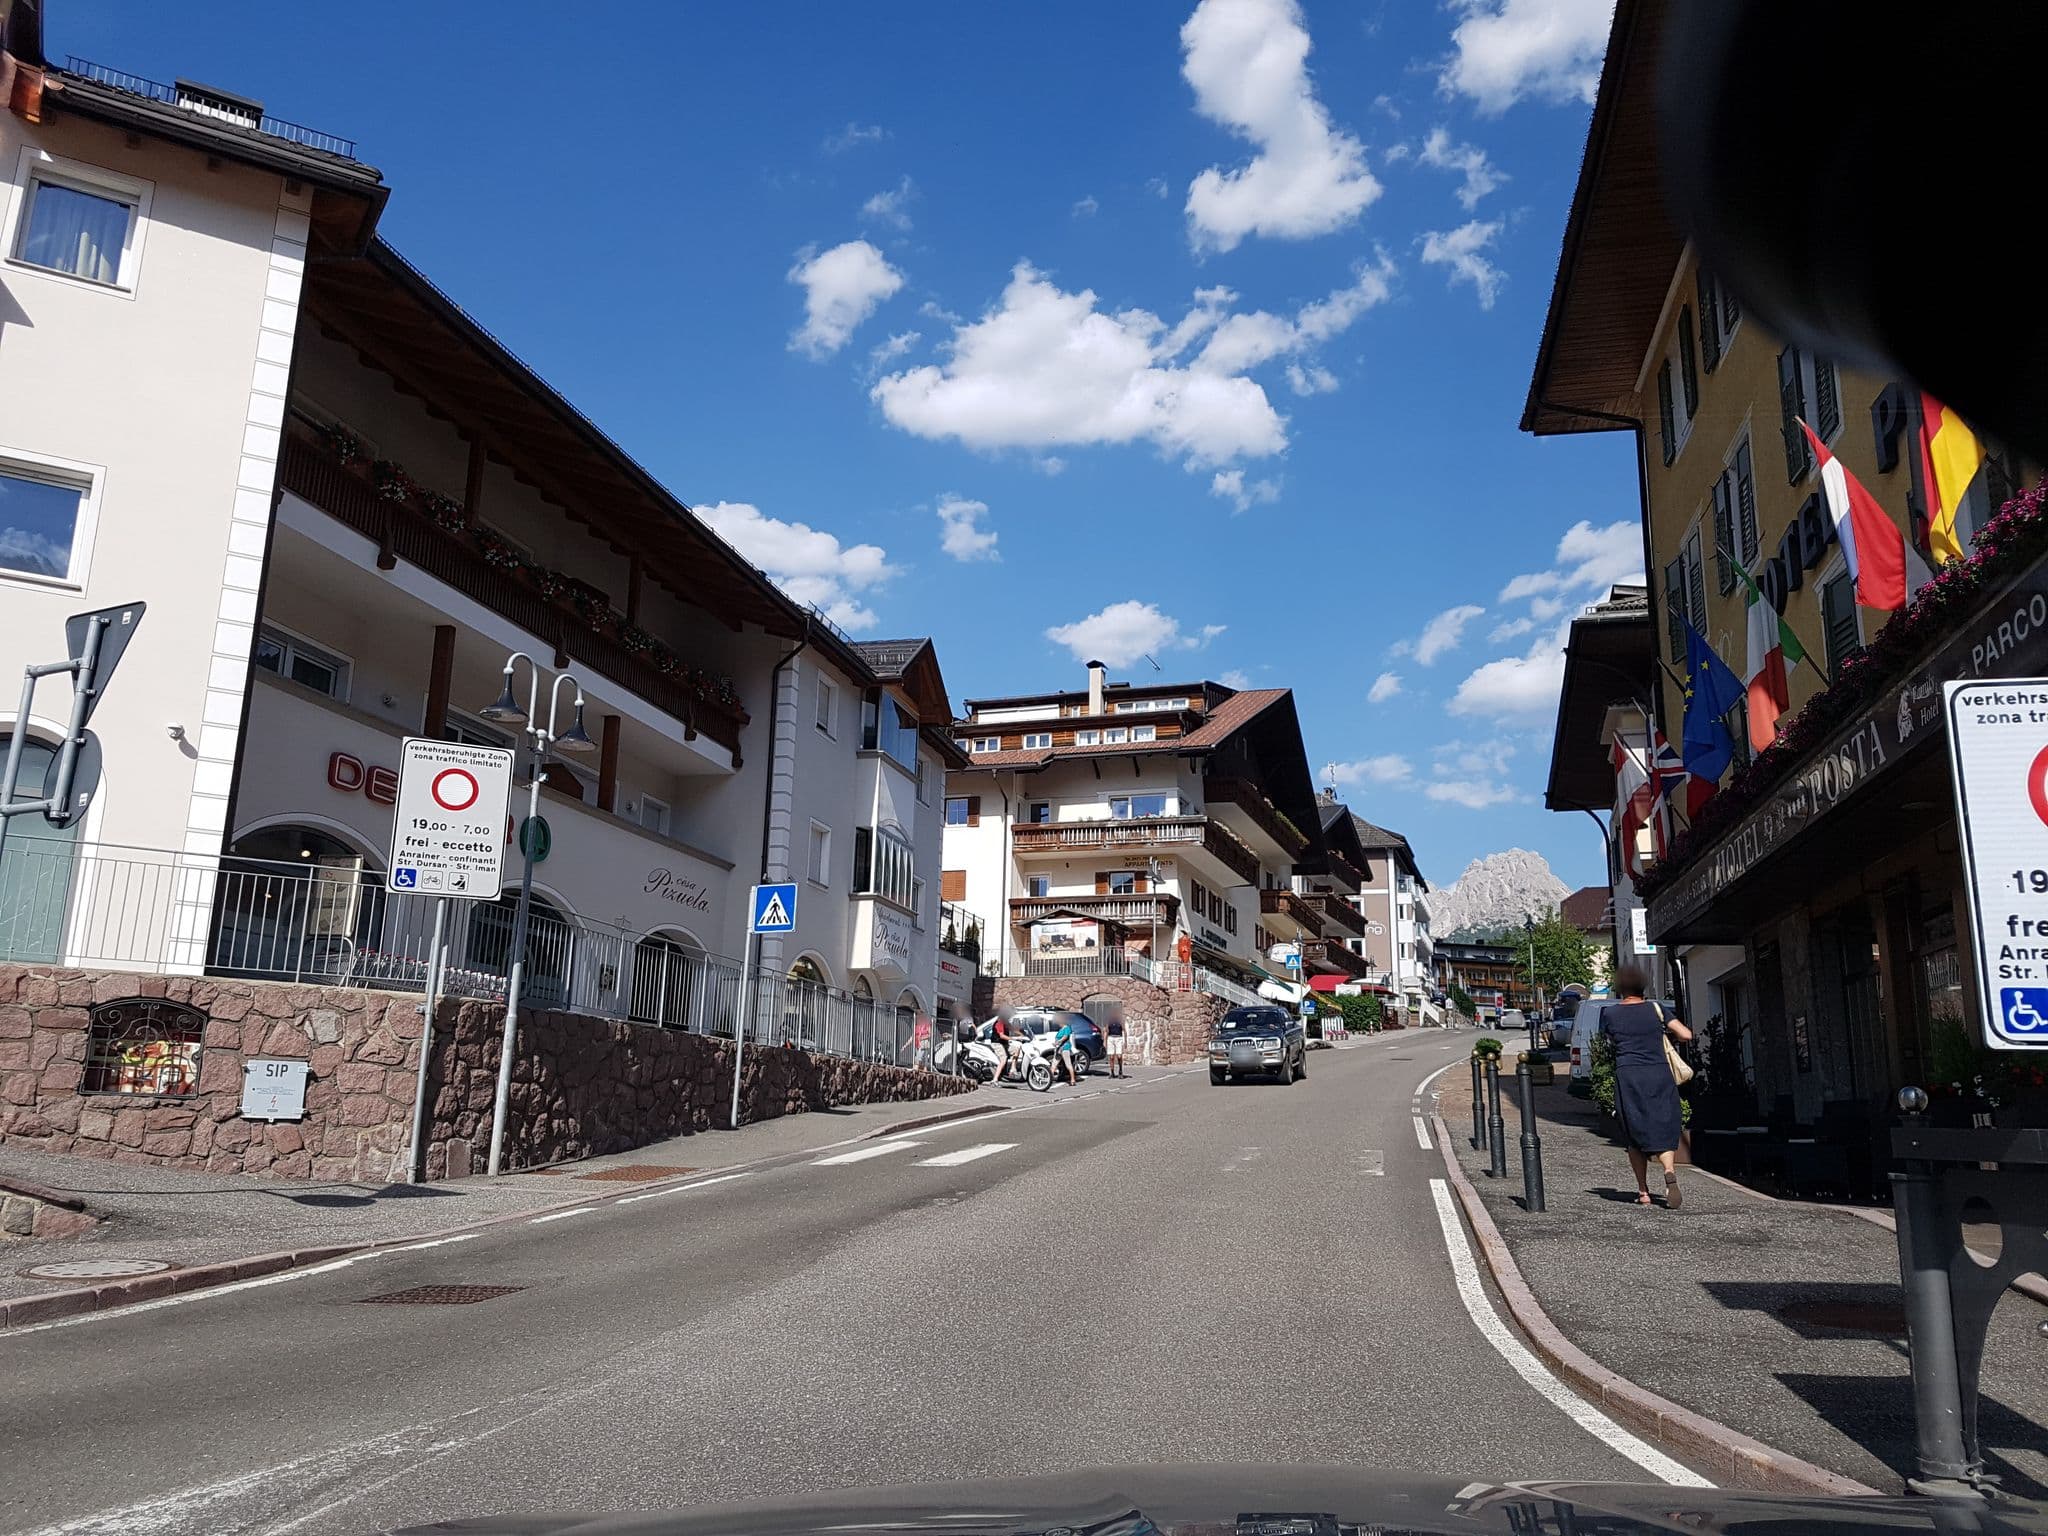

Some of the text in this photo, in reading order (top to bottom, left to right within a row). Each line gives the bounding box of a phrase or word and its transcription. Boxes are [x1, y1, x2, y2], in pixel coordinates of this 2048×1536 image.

[1972, 593, 2047, 676] PARCO
[1920, 697, 1939, 727] Hotel
[1976, 710, 2048, 724] zona tr
[410, 744, 508, 762] verkehrsberuhigte Zone
[414, 753, 502, 769] zona traffico limitato
[1714, 720, 1887, 888] HOTEL POSTA
[463, 824, 490, 835] 7.00
[405, 835, 429, 847] frei
[442, 841, 493, 853] eccetto
[399, 850, 440, 860] Anrainer
[448, 855, 496, 865] confinanti
[397, 858, 414, 866] Str.
[416, 859, 448, 869] Dursan
[456, 862, 472, 871] Str.
[475, 864, 496, 873] Iman
[676, 878, 696, 890] casa
[1998, 964, 2038, 979] Str.
[266, 1063, 289, 1078] SIP
